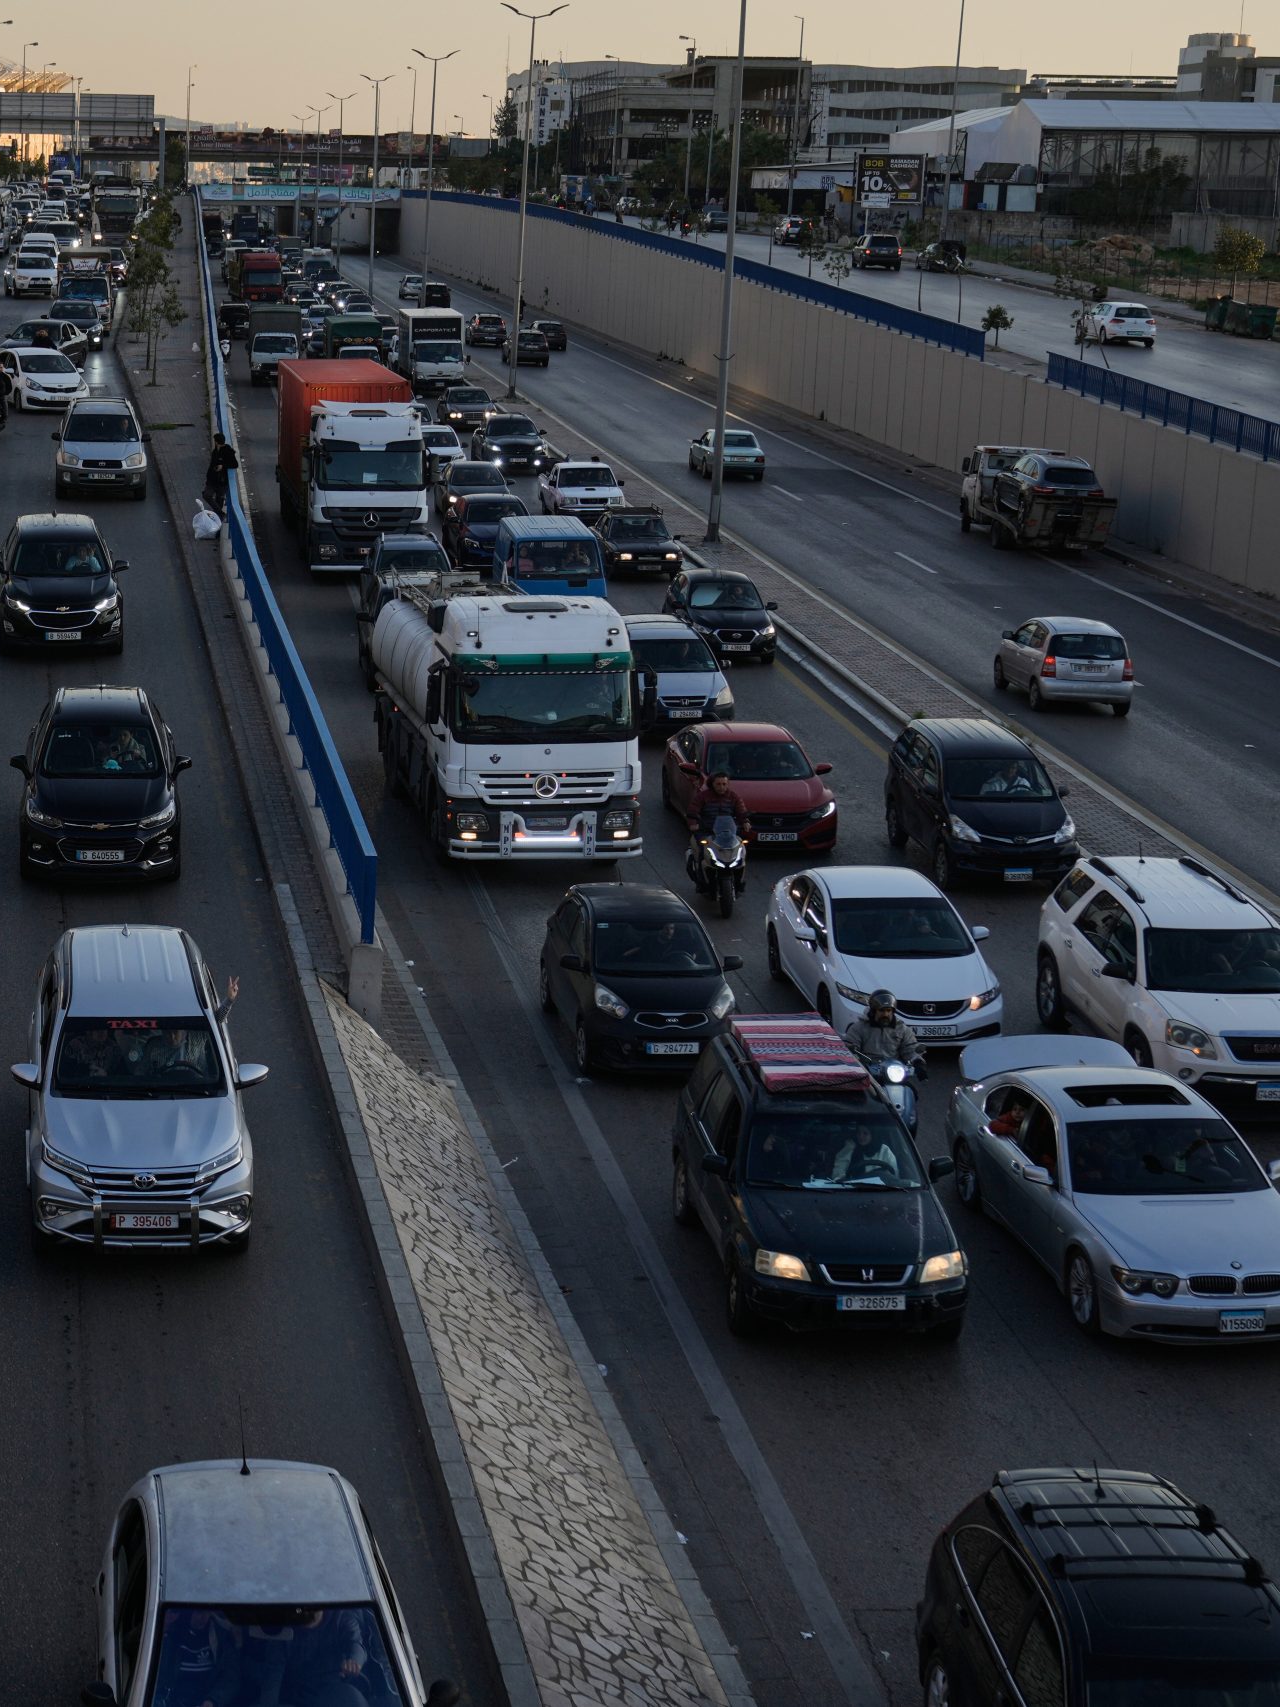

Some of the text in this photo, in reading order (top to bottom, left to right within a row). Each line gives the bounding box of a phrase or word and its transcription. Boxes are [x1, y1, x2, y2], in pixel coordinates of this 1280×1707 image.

[759, 833, 780, 841] GF20
[82, 851, 120, 860] G 640555
[107, 1019, 158, 1029] TAXI
[922, 1026, 952, 1036] 396022
[653, 1043, 694, 1053] G 284772
[118, 1215, 172, 1228] P 395406
[859, 1297, 898, 1309] 326675
[1221, 1318, 1264, 1331] N155090
